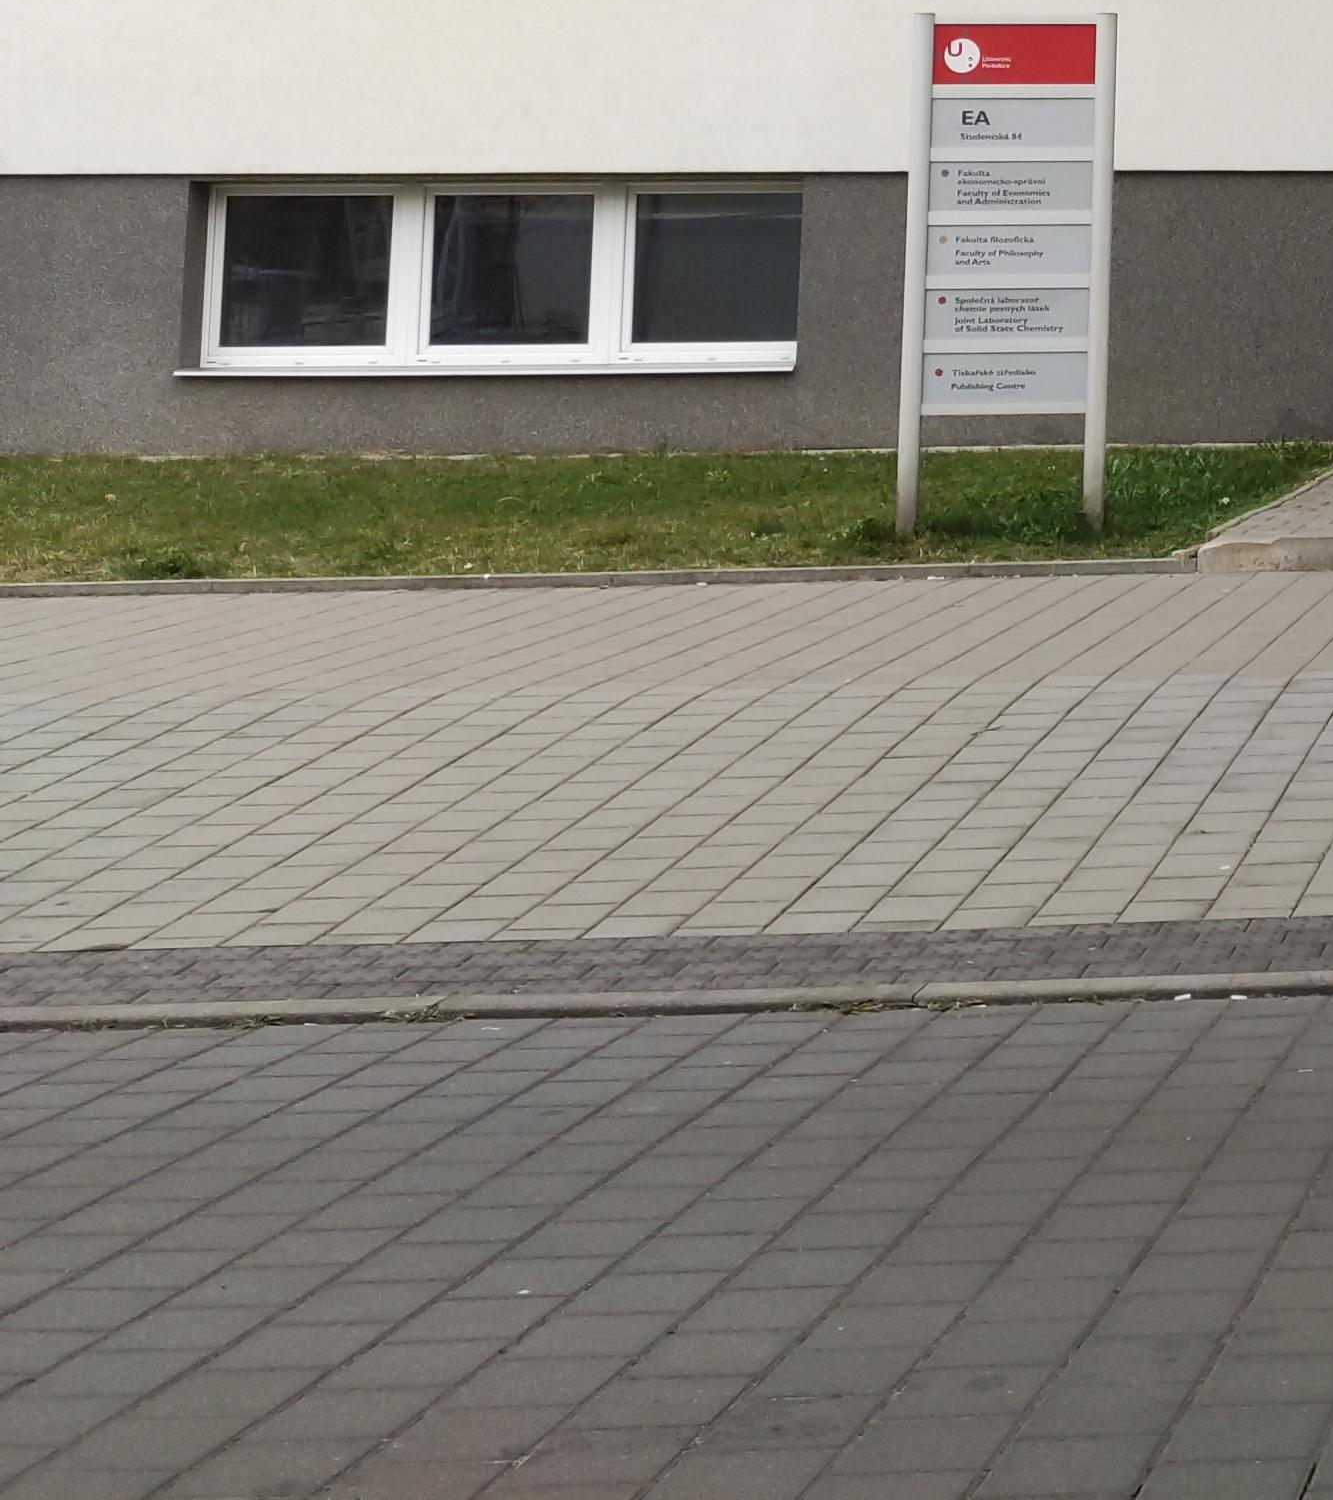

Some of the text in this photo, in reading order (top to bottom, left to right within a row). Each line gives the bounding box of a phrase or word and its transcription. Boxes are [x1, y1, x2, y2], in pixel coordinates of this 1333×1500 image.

[961, 110, 991, 126] EA
[957, 169, 991, 177] Fakulta
[957, 189, 1051, 198] Faculty of Economics
[956, 197, 973, 205] and
[955, 250, 986, 258] Faculty
[998, 250, 1045, 259] Philosophy
[954, 317, 1029, 326] Joint Laboratory
[1016, 324, 1064, 333] Chemistry
[951, 383, 994, 391] Publishing
